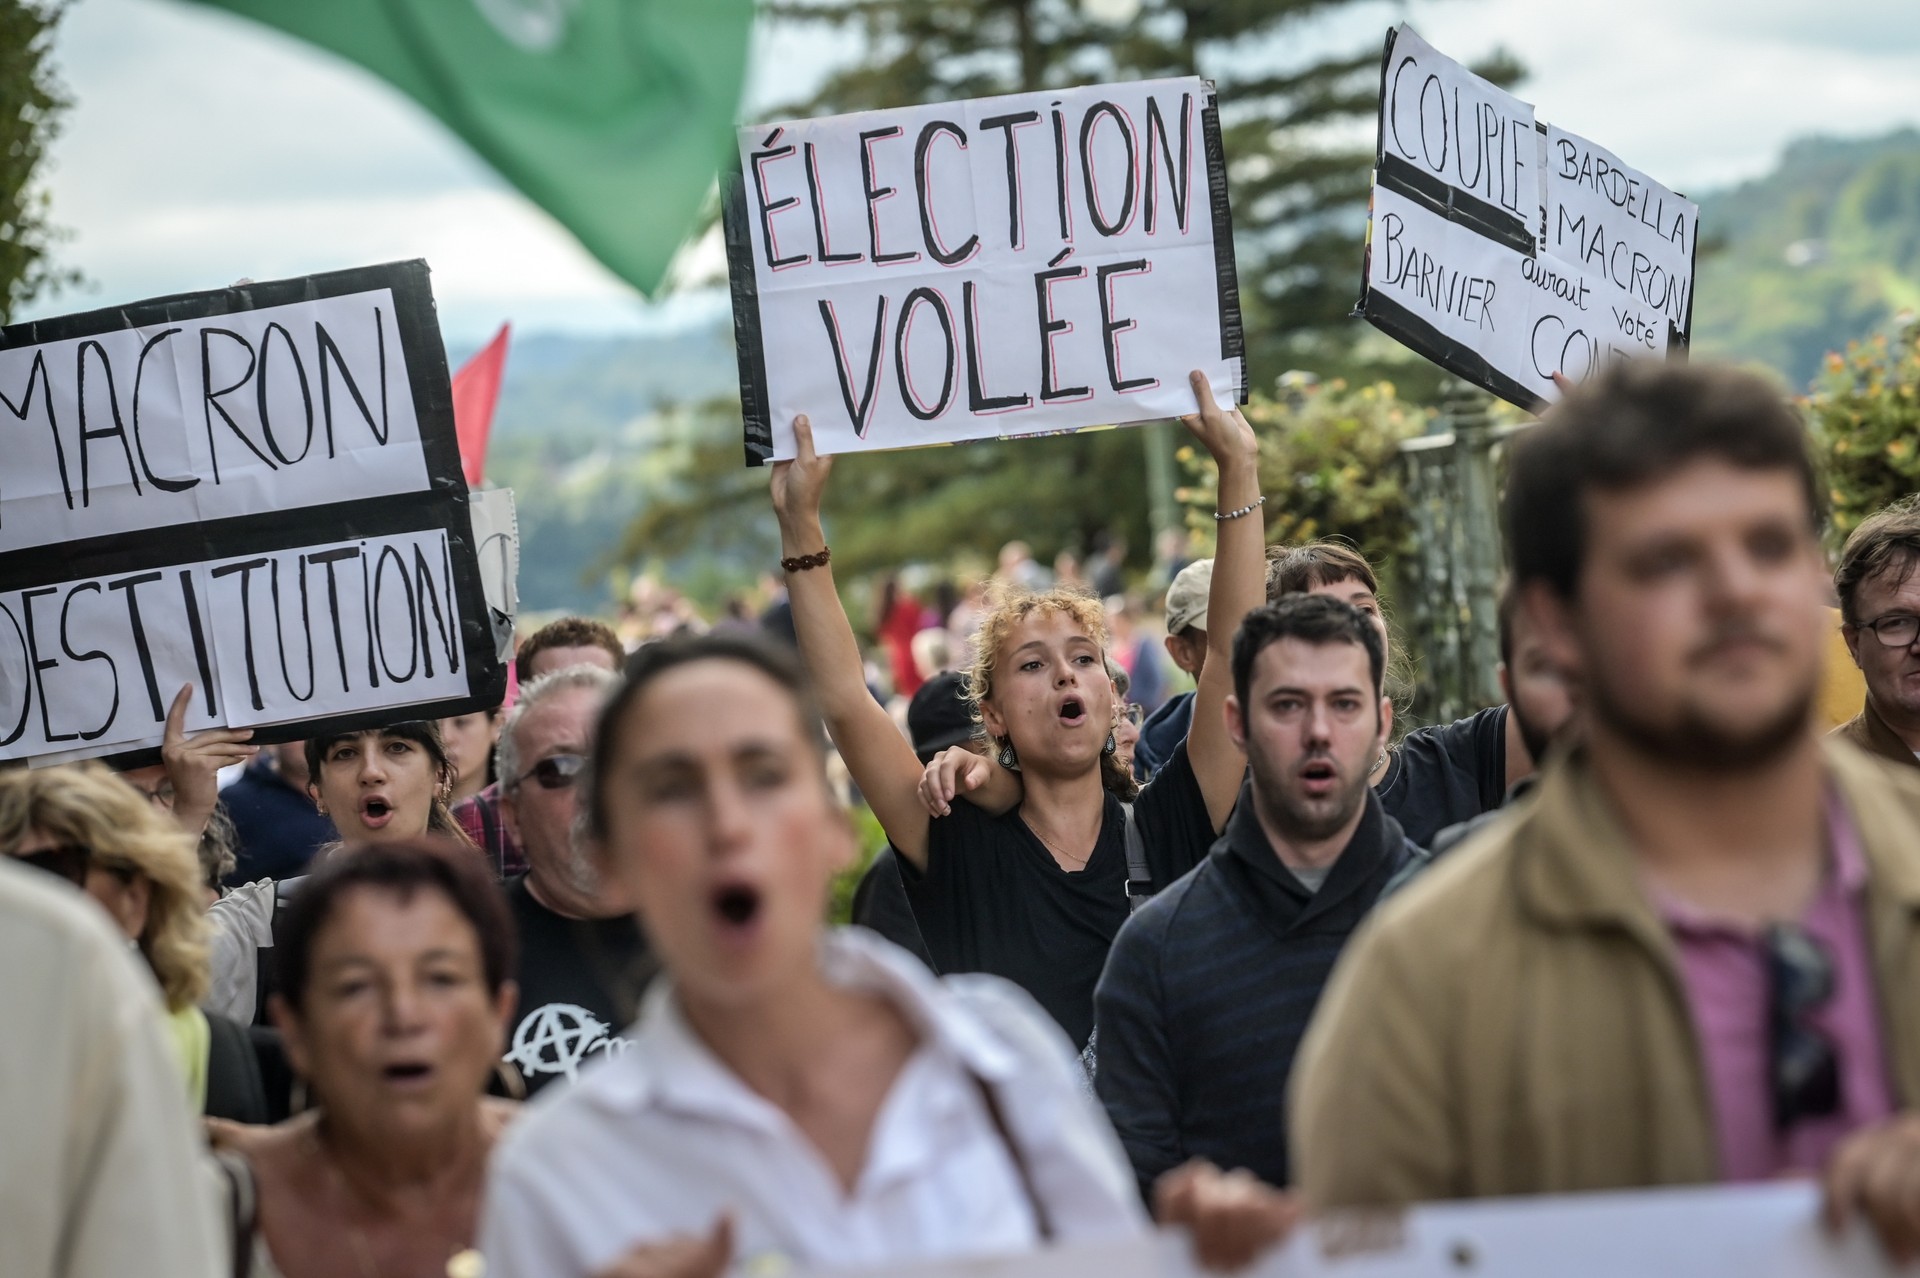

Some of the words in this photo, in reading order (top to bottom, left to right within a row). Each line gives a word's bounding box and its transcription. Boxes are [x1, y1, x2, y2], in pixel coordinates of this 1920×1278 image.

[751, 93, 1192, 271] ÉLECTION
[1391, 56, 1529, 218] COUPLE
[1556, 139, 1686, 255] BARDELLA
[1380, 213, 1496, 332] BARNIER
[1521, 257, 1590, 310] aurait
[1557, 203, 1686, 323] MACRON
[0, 307, 389, 510] MACRON
[818, 248, 1160, 440] VOLÉE
